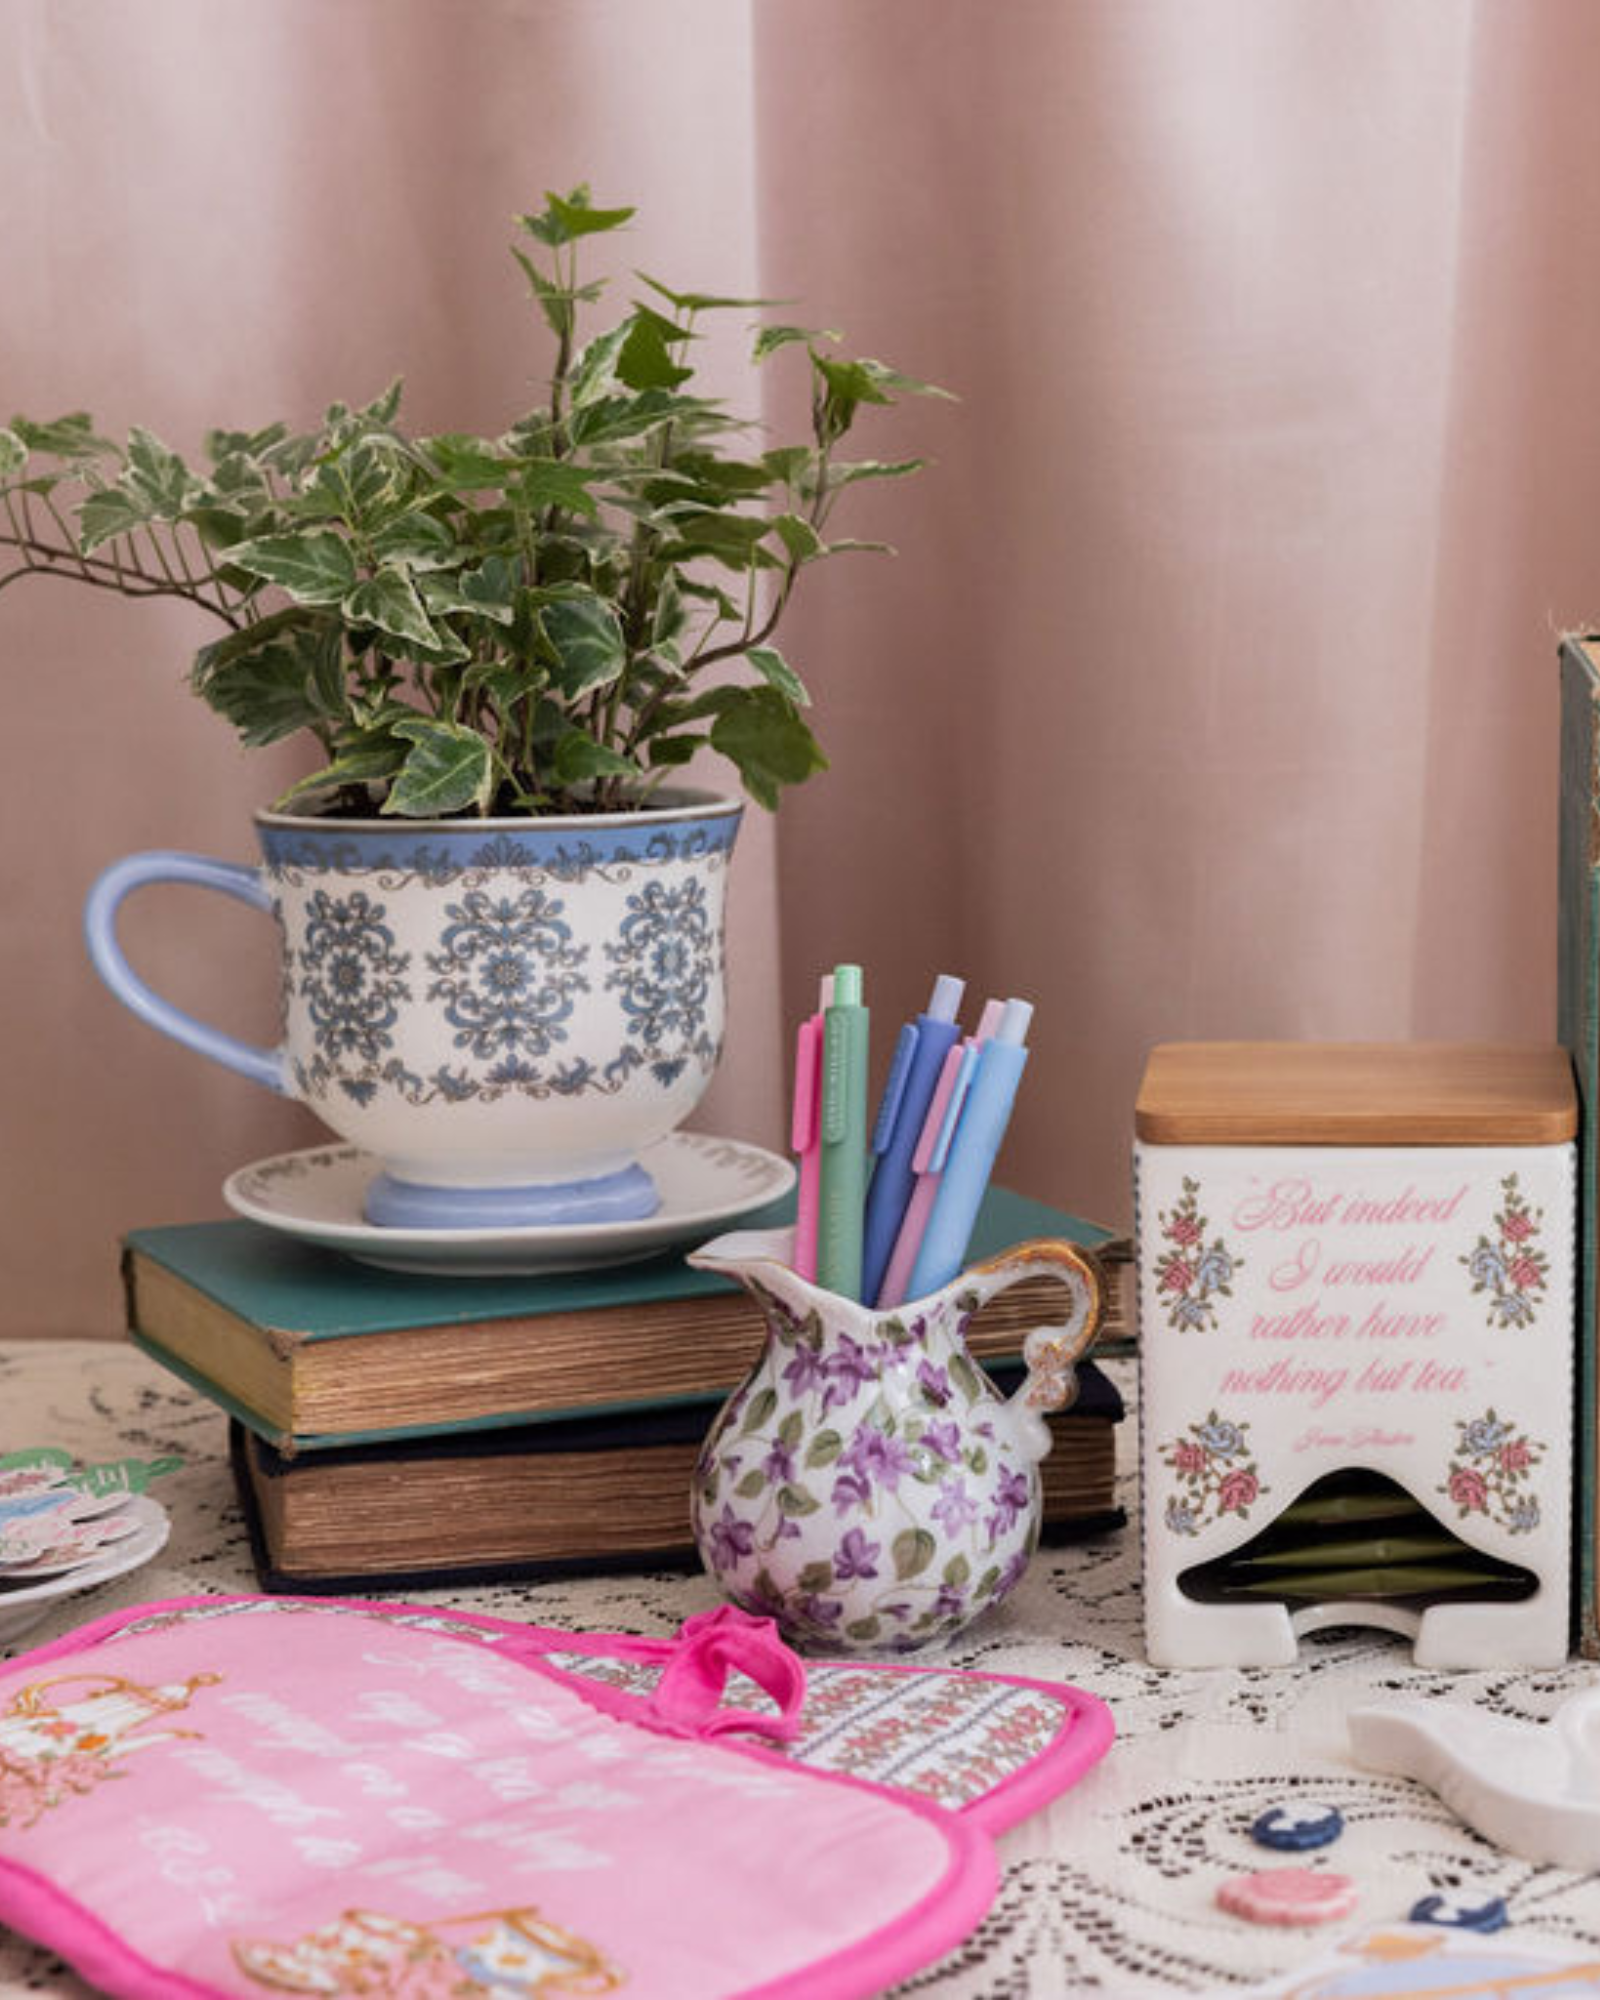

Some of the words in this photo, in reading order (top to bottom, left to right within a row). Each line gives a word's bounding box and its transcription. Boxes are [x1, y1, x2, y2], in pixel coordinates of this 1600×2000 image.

[1341, 1184, 1470, 1226] indeed
[1321, 1243, 1435, 1287] would
[1250, 1300, 1351, 1341] rather
[1354, 1300, 1446, 1340] have
[1220, 1354, 1348, 1410] nothing
[1353, 1356, 1413, 1394] but
